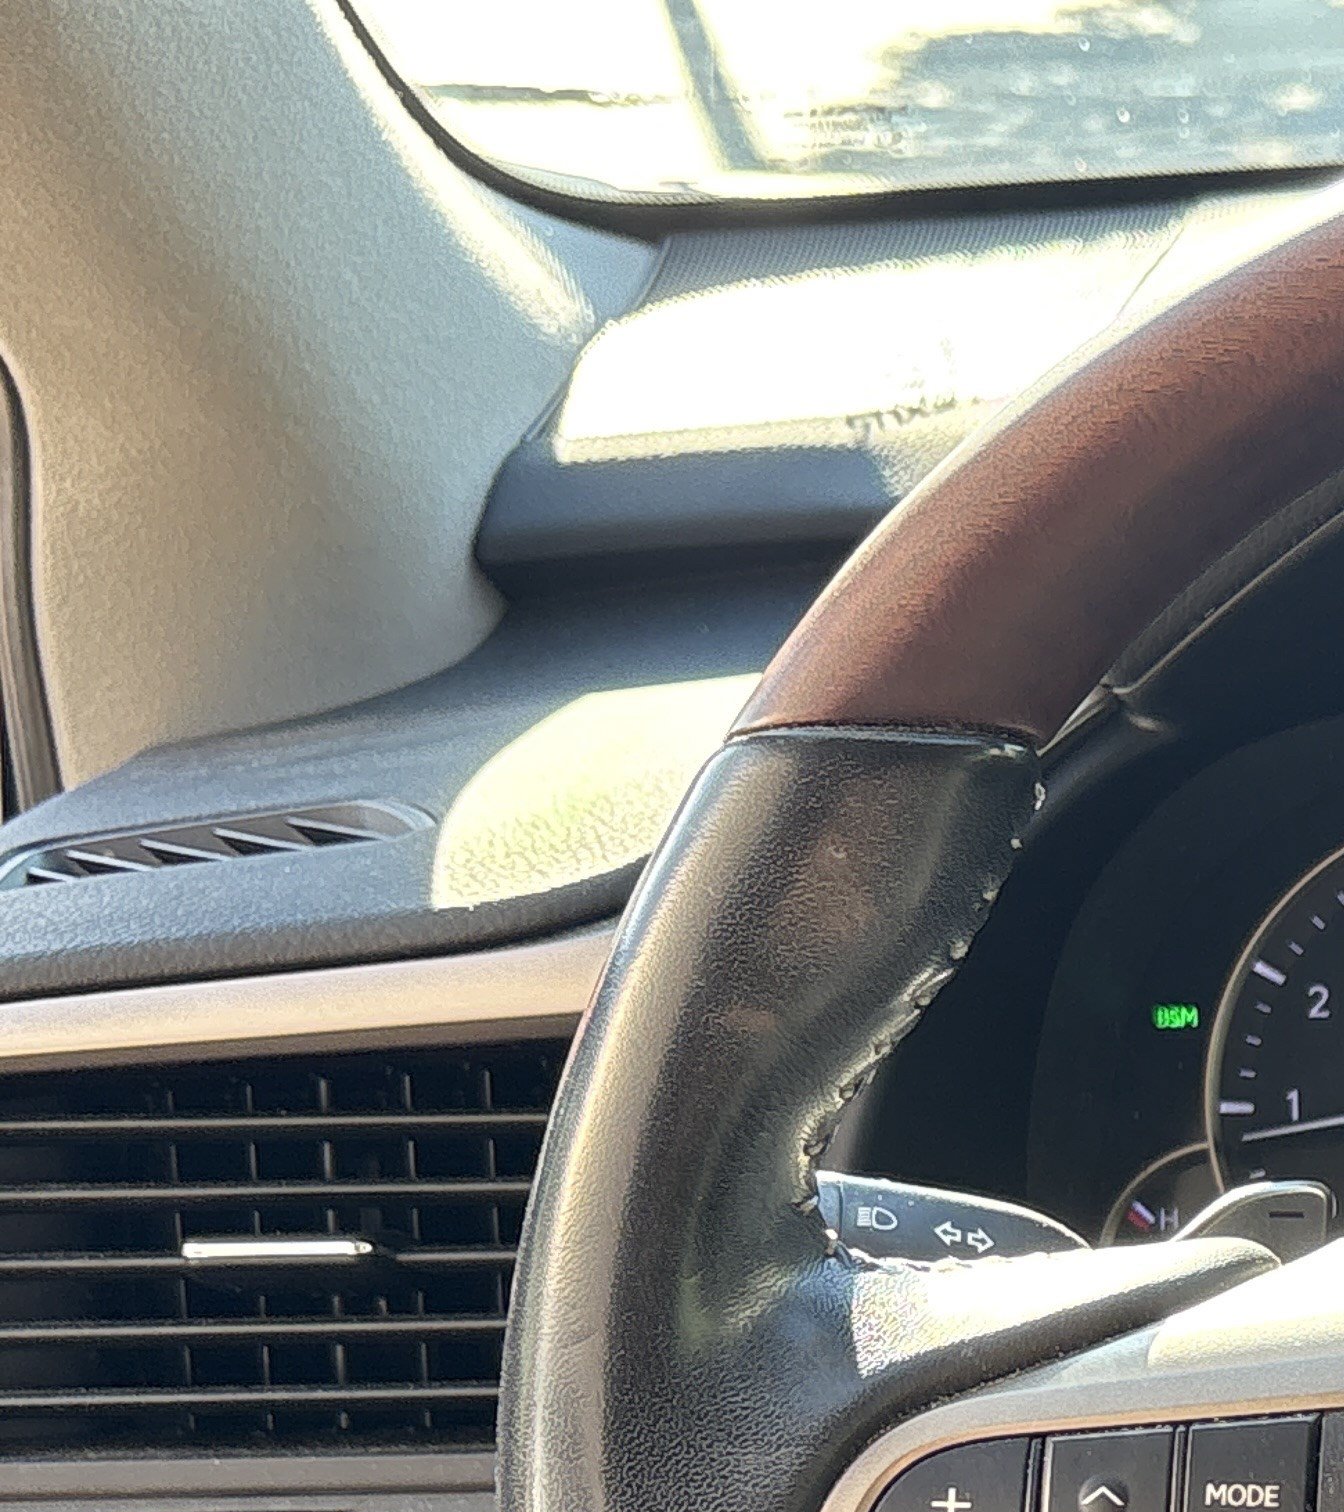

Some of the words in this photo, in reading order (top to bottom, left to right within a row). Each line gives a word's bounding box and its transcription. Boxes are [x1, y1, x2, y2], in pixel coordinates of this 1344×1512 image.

[1307, 985, 1331, 1019] 2
[1286, 1089, 1300, 1122] 1
[1160, 1206, 1179, 1231] H
[1204, 1483, 1280, 1508] MODE
